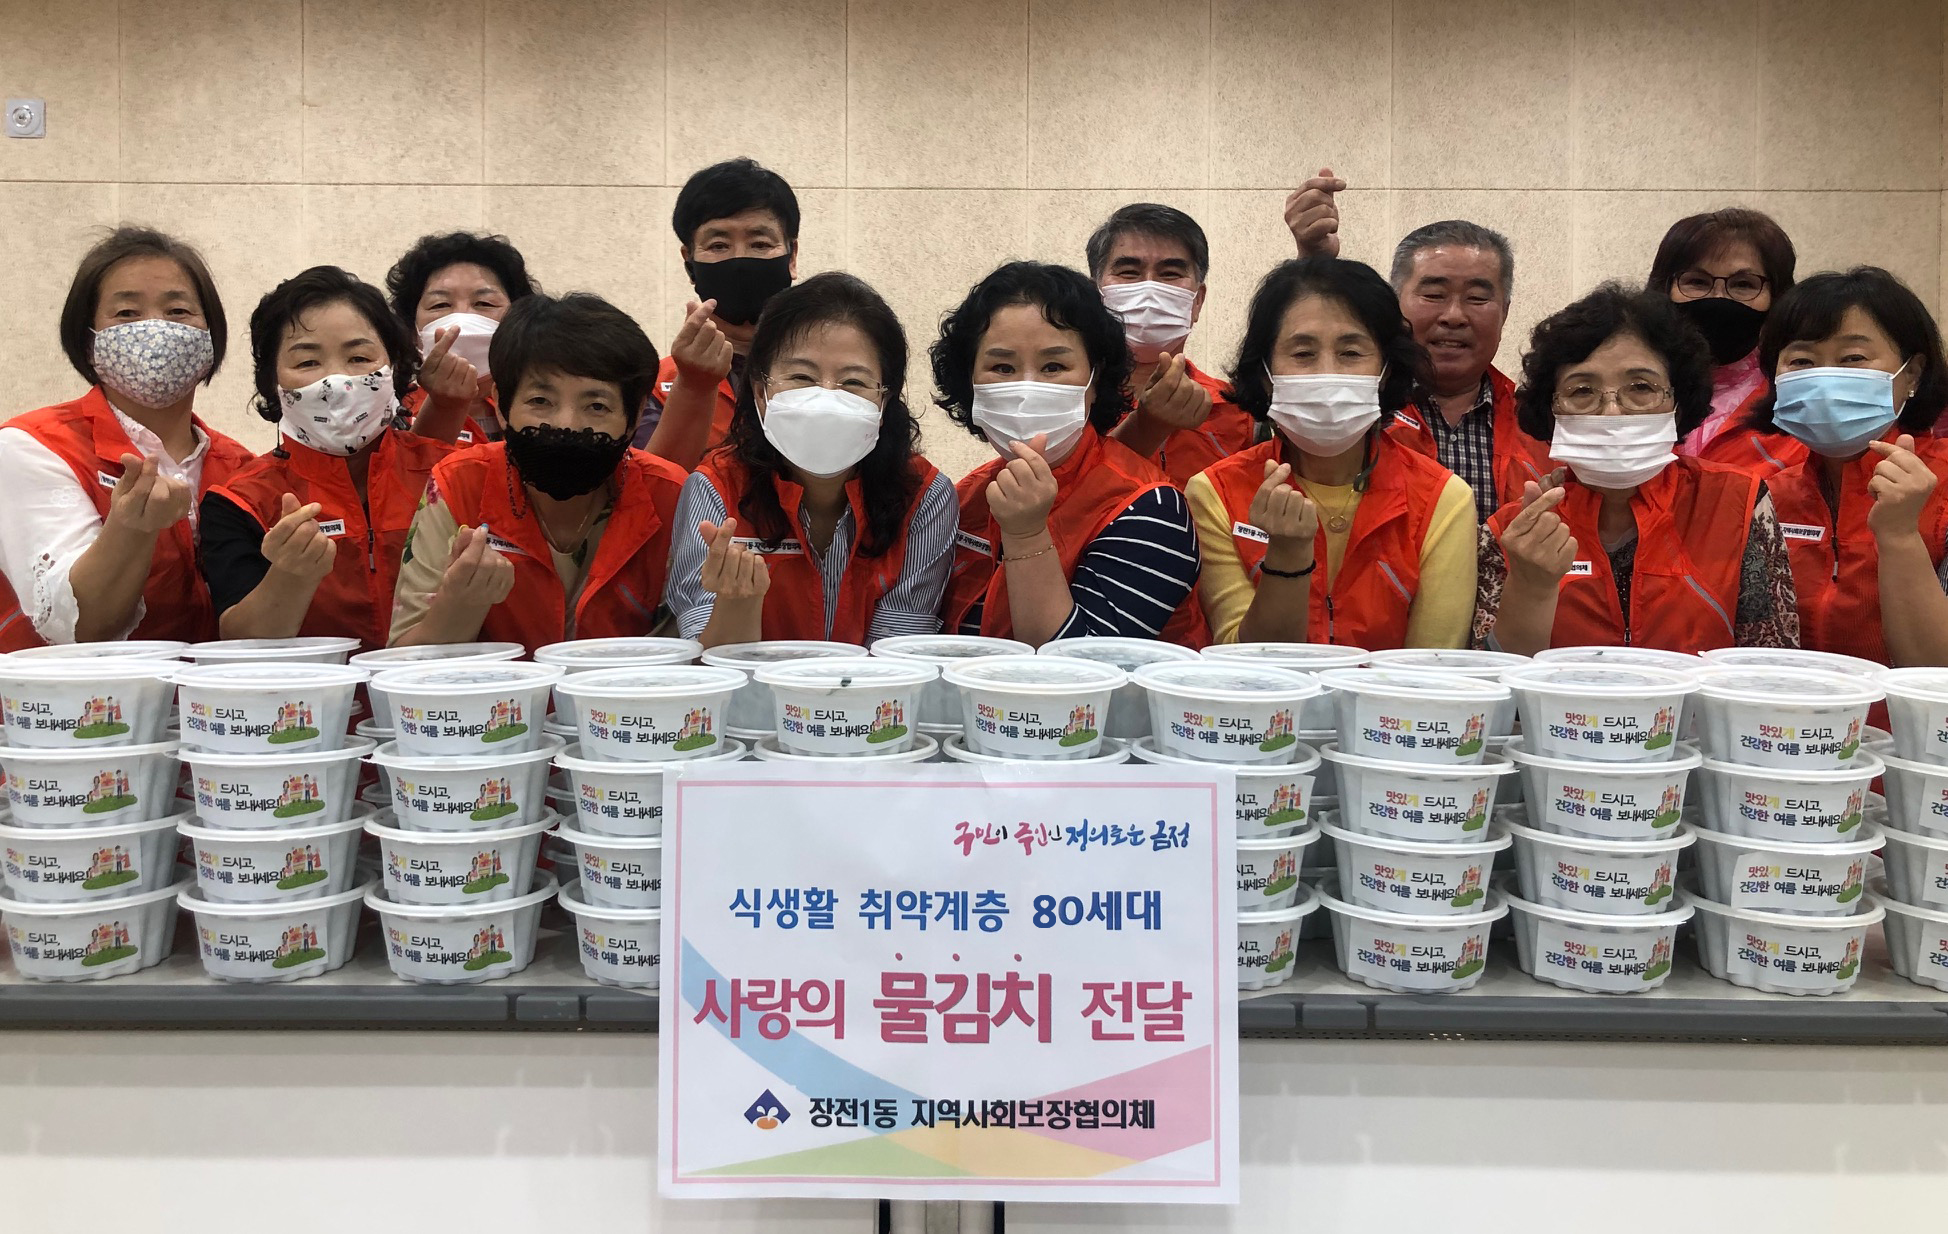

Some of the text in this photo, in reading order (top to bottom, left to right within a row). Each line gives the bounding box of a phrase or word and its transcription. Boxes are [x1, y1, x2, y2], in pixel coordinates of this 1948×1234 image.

[22, 702, 52, 716] 드시고,
[215, 708, 248, 720] 드시고,
[427, 709, 461, 722] 드시고,
[17, 717, 31, 729] 여름
[620, 716, 655, 729] 드시고,
[814, 710, 848, 723] 드시고,
[1008, 710, 1042, 726] 드시고,
[1603, 716, 1639, 730] 드시고,
[209, 721, 226, 735] 여름
[420, 724, 439, 738] 여름
[806, 724, 826, 737] 여름
[1000, 724, 1020, 738] 여름
[1218, 718, 1253, 731] 드시고,
[1416, 720, 1451, 734] 드시고,
[612, 729, 632, 742] 여름
[1198, 729, 1219, 744] 여름
[1395, 734, 1417, 748] 여름
[1582, 730, 1605, 744] 여름
[1800, 727, 1834, 741] 드시고,
[1776, 740, 1800, 756] 여름
[29, 779, 61, 792] 드시고,
[221, 782, 252, 796] 드시고,
[418, 785, 451, 798] 드시고,
[23, 794, 39, 806] 여름
[608, 789, 641, 803] 드시고,
[1236, 794, 1258, 806] 시고,
[1423, 796, 1458, 809] 드시고,
[1600, 793, 1636, 807] 드시고,
[216, 797, 231, 811] 여름
[411, 799, 429, 812] 여름
[1785, 799, 1822, 813] 드시고,
[601, 804, 619, 818] 여름
[623, 806, 662, 820] 보내세요
[1401, 809, 1424, 823] 여름
[1590, 806, 1613, 820] 여름
[1773, 811, 1797, 826] 여름
[954, 820, 1008, 857] 구민이
[1065, 822, 1145, 851] 정의로운
[1150, 819, 1191, 852] 금정
[28, 855, 60, 869] 드시고,
[222, 856, 255, 869] 드시고,
[410, 859, 442, 872] 드시고,
[611, 862, 644, 876] 드시고,
[23, 871, 39, 882] 여름
[217, 870, 233, 884] 여름
[1236, 864, 1257, 876] 시고,
[1785, 868, 1821, 883] 드시고,
[404, 872, 421, 886] 여름
[604, 875, 622, 889] 여름
[1411, 871, 1446, 886] 드시고,
[1594, 870, 1630, 885] 드시고,
[1390, 882, 1411, 898] 여름
[1583, 884, 1605, 898] 여름
[1774, 882, 1797, 896] 여름
[729, 888, 1161, 932] 식생활 취약계층 80세대
[28, 932, 60, 945] 드시고,
[219, 934, 251, 947] 드시고,
[411, 936, 444, 949] 드시고,
[608, 938, 641, 952] 드시고,
[23, 946, 39, 959] 여름
[1238, 940, 1260, 953] 시고,
[1411, 945, 1446, 959] 드시고,
[1602, 945, 1637, 961] 드시고,
[1784, 945, 1821, 960] 드시고,
[214, 948, 231, 961] 여름
[405, 948, 422, 962] 여름
[601, 950, 661, 966] 여름 보내세요
[1389, 958, 1411, 972] 여름
[1580, 958, 1604, 972] 여름
[1773, 956, 1797, 972] 여름
[693, 971, 1193, 1044] 사랑의 물김치 전달
[809, 1098, 1155, 1129] 장전1동 지역사회보장협의체
